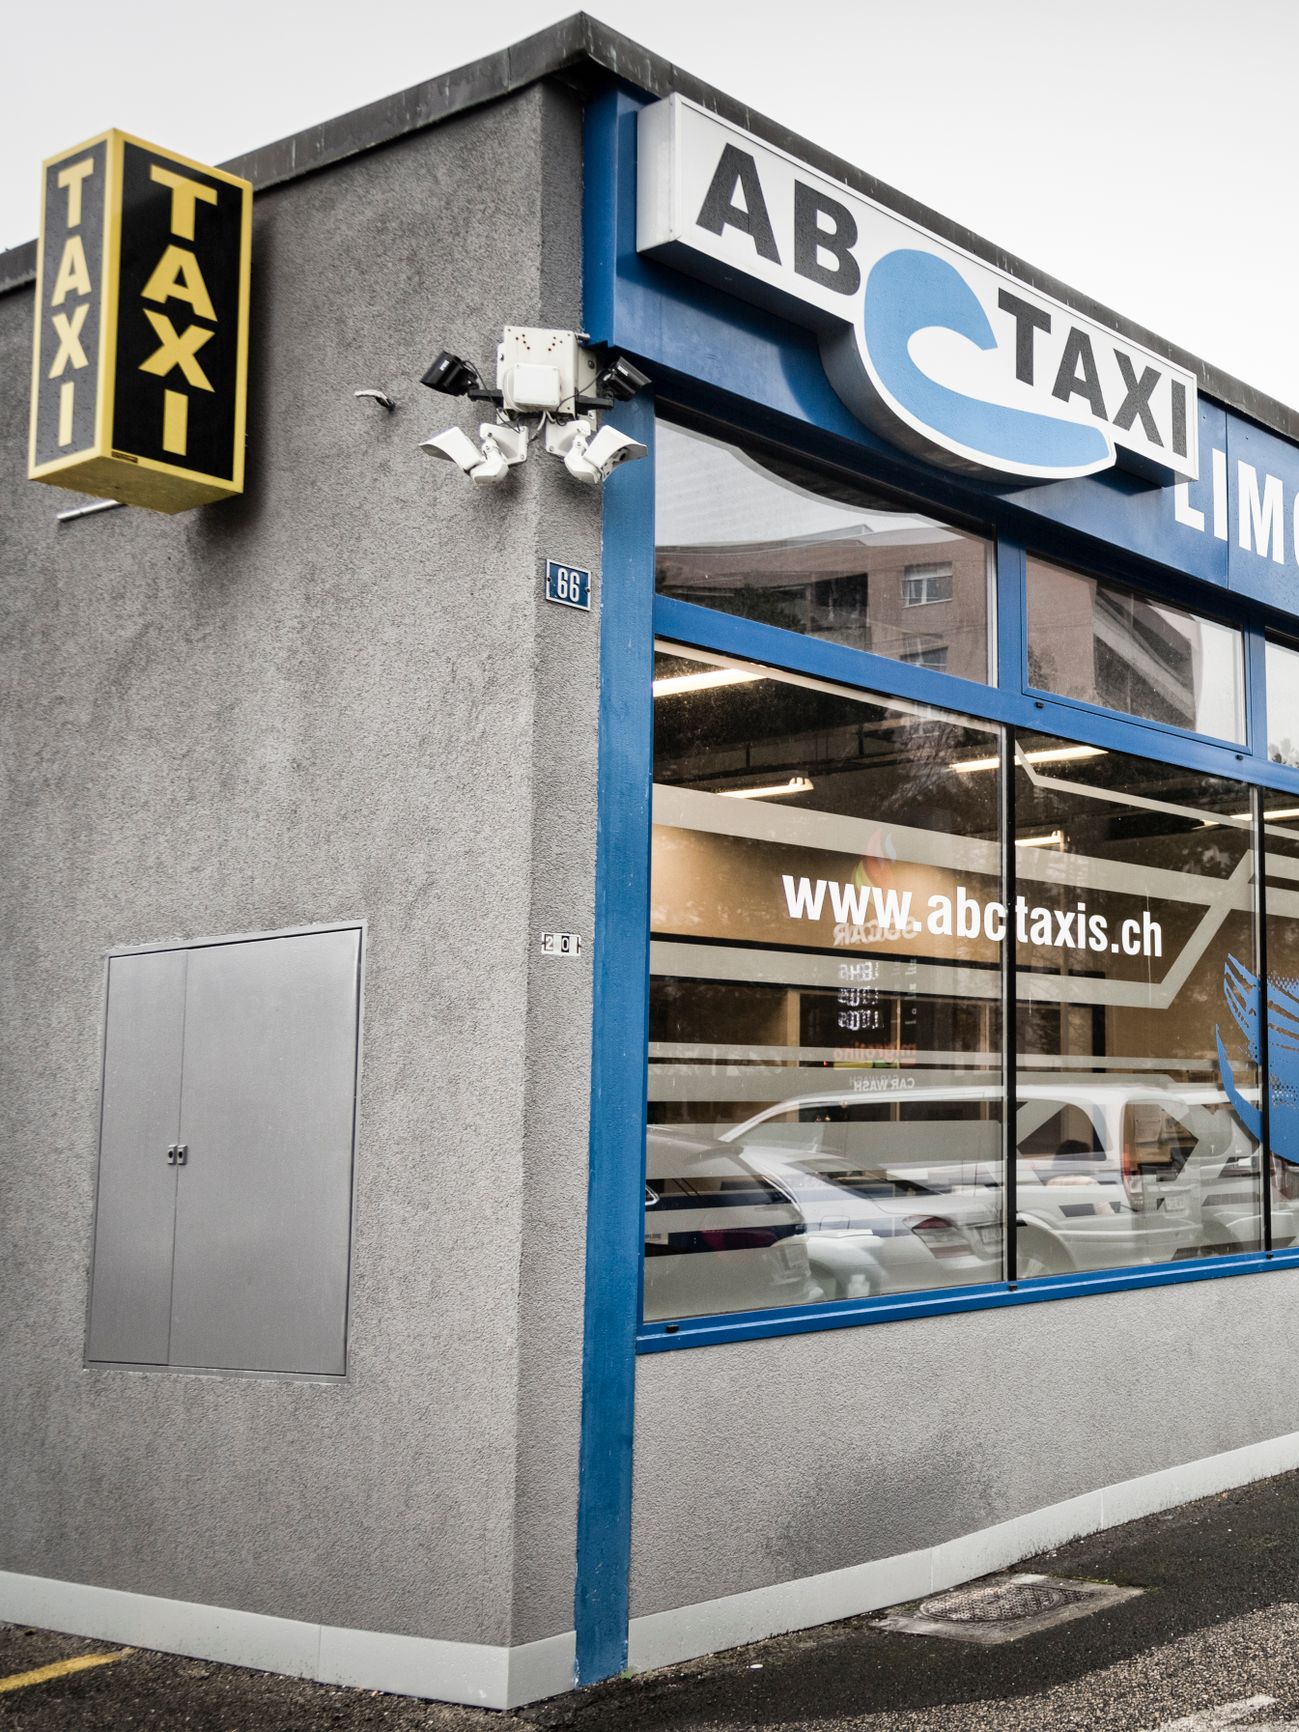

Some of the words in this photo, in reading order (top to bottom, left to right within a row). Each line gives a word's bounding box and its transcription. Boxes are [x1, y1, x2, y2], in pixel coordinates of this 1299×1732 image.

[48, 158, 95, 448] TAXI
[137, 163, 218, 456] TAXI
[997, 287, 1188, 459] TAXI
[557, 567, 580, 602] 66
[782, 875, 1163, 958] www.abctaxis.ch
